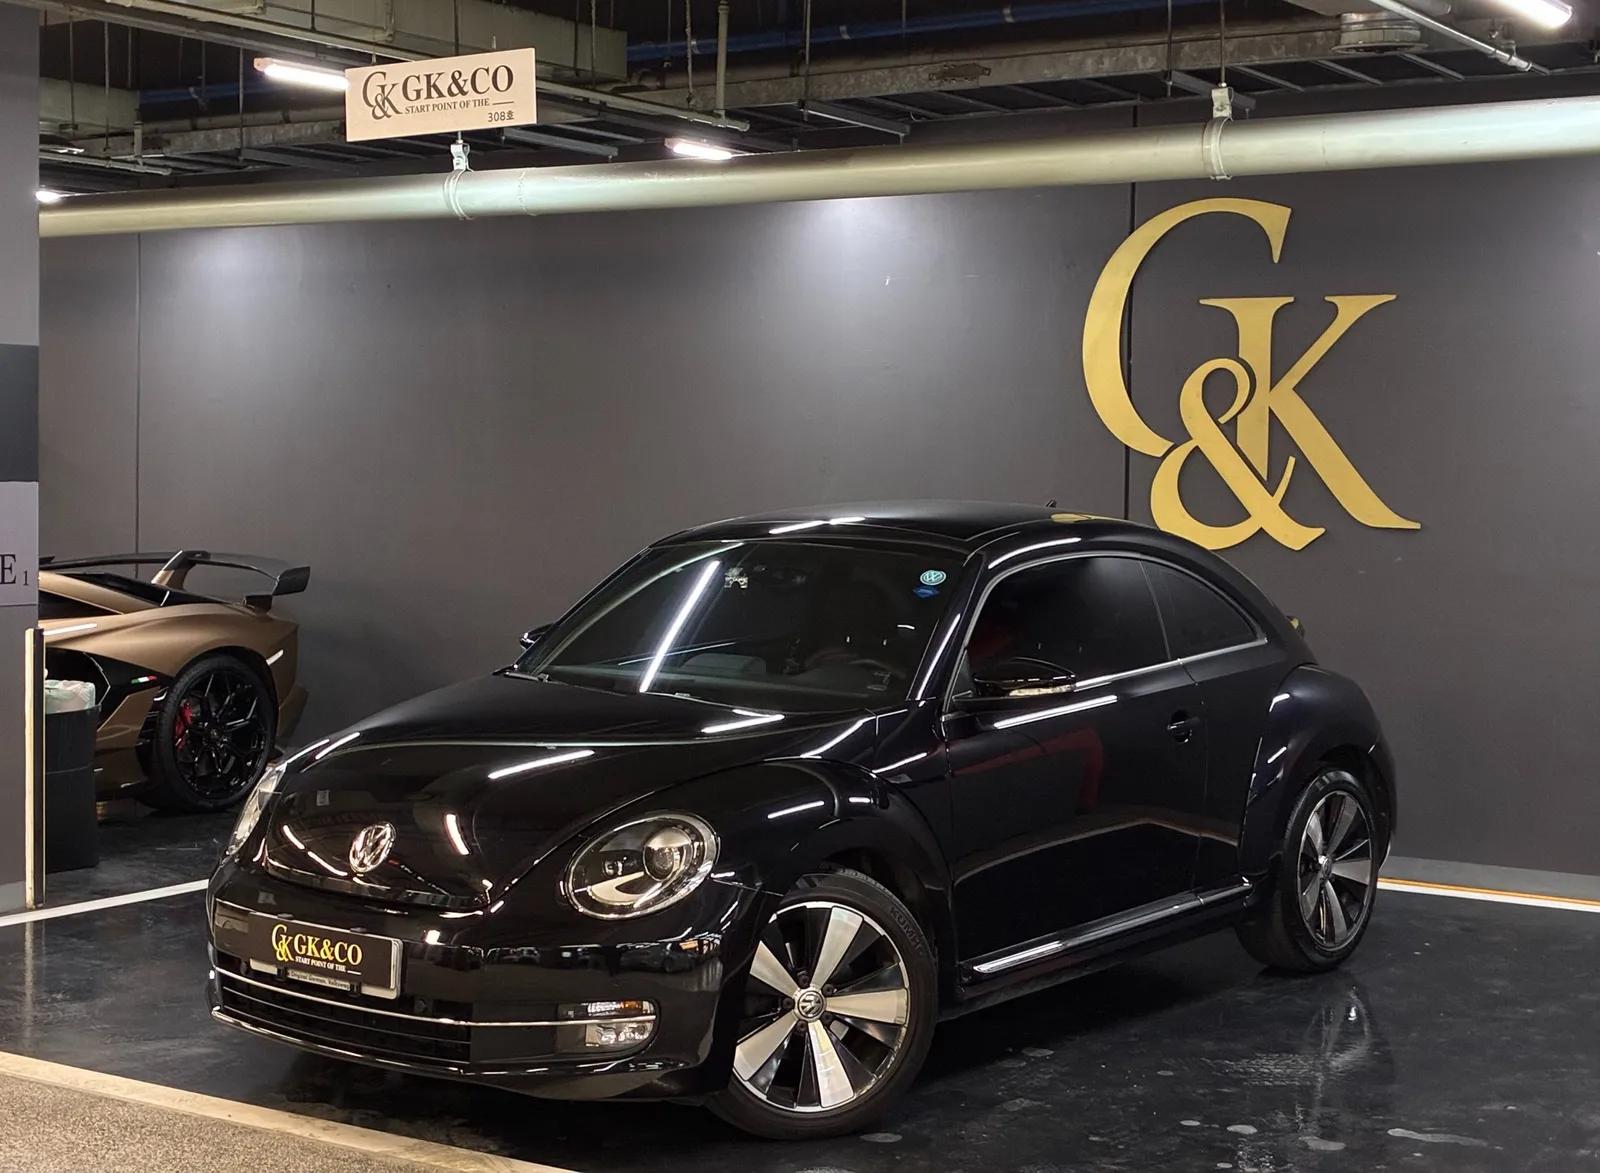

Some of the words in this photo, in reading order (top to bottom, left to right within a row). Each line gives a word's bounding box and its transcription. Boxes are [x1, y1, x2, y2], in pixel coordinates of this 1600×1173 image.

[401, 64, 514, 102] GK&CO
[405, 104, 430, 115] START
[432, 102, 457, 112] POINT
[459, 100, 471, 109] OF
[473, 98, 490, 108] THE
[487, 110, 515, 123] 308호
[293, 933, 363, 966] GK&CO
[295, 956, 310, 966] START
[311, 958, 326, 969] POINT
[327, 961, 335, 970] OF
[335, 963, 346, 972] THE
